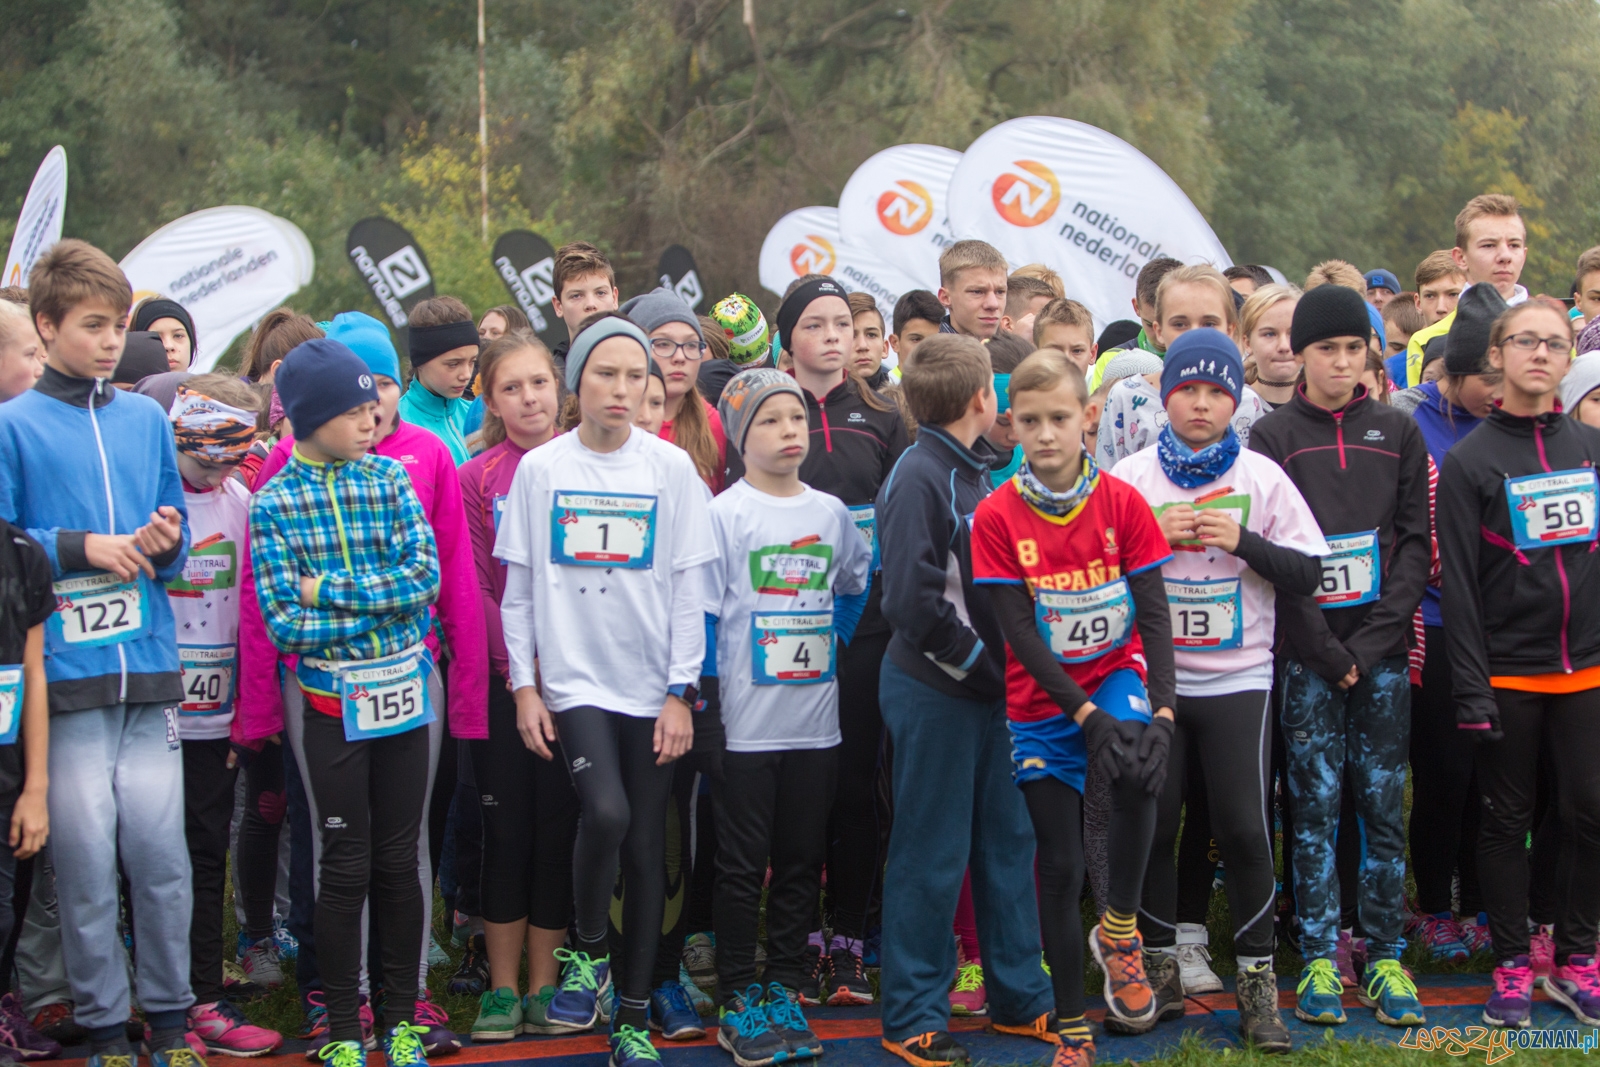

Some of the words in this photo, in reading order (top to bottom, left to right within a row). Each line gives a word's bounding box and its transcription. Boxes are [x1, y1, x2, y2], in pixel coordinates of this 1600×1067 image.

[169, 248, 243, 293] nationale
[1543, 499, 1583, 529] 58
[597, 523, 609, 551] 1
[1017, 538, 1039, 567] 8
[1320, 564, 1351, 593] 61
[72, 598, 130, 634] 122
[1178, 609, 1210, 637] 13
[1067, 616, 1109, 646] 49
[792, 641, 811, 669] 4
[187, 674, 221, 701] 40
[366, 686, 415, 722] 155
